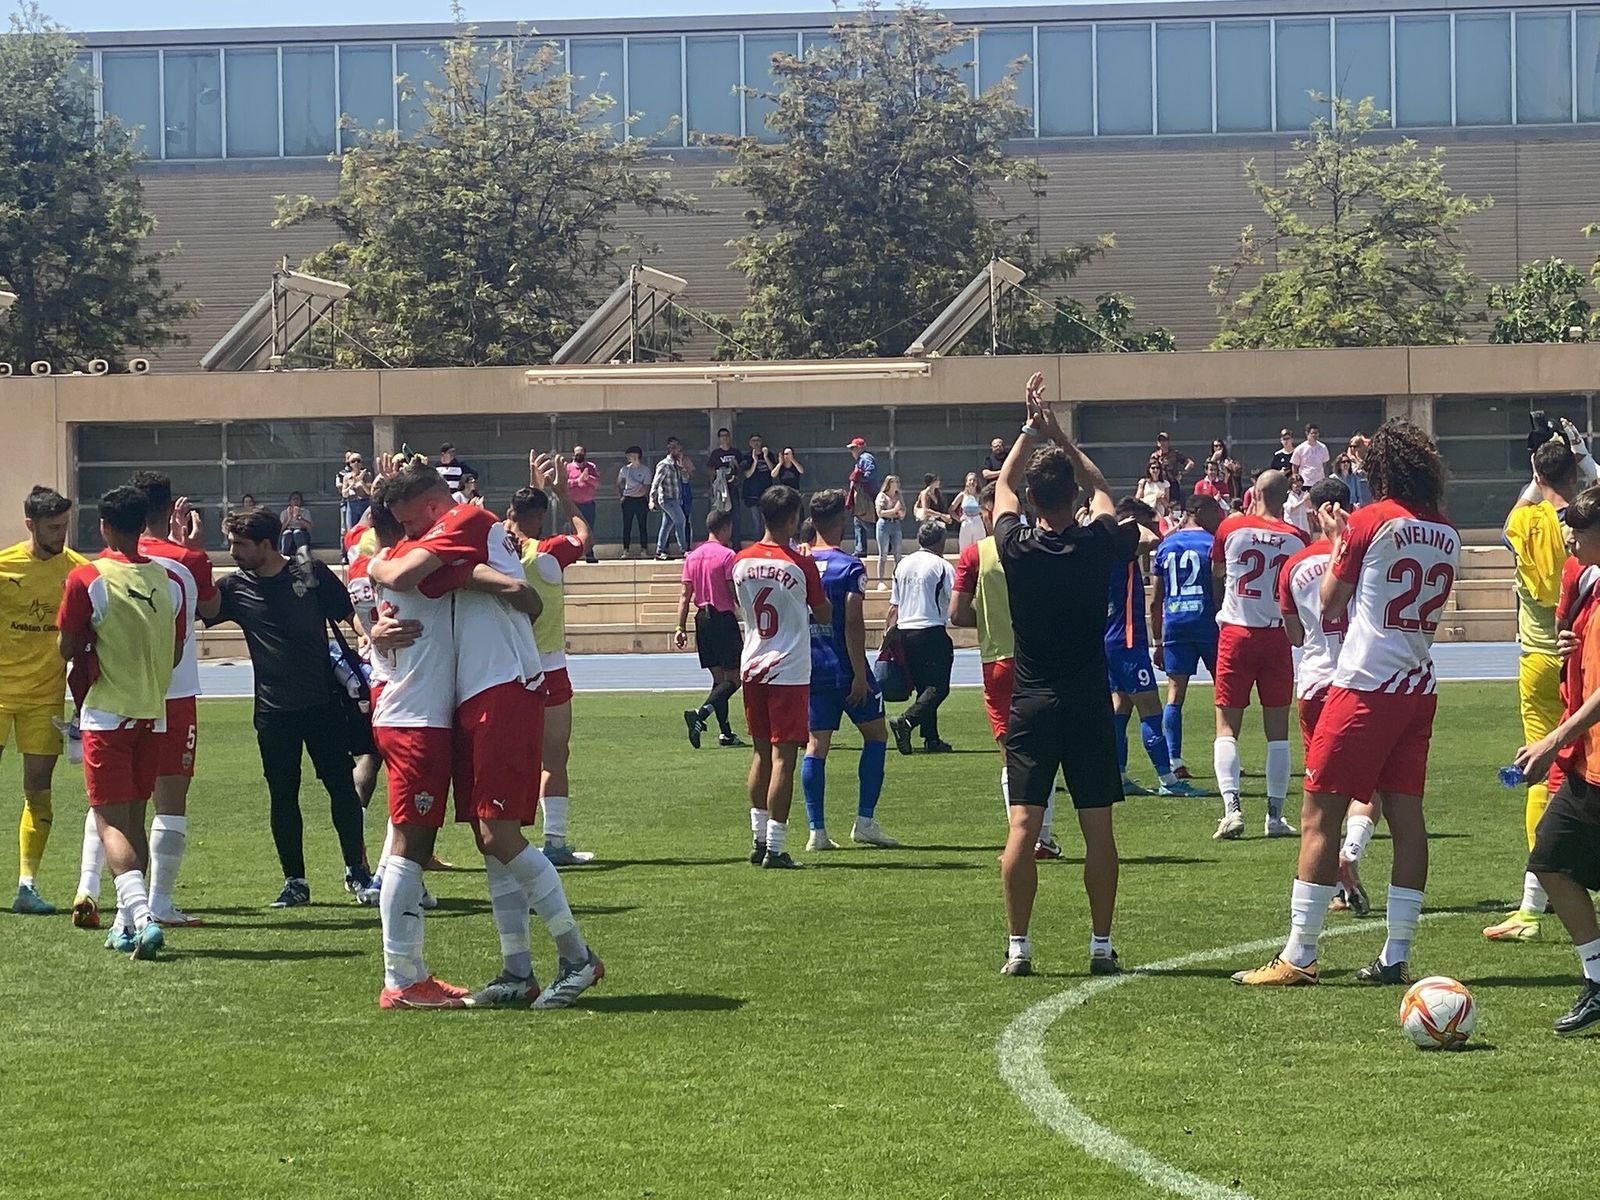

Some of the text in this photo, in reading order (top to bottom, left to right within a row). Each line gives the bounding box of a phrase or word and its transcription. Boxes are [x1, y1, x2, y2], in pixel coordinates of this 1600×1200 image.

[1251, 533, 1286, 549] ALEX
[1393, 526, 1454, 555] AVELINO
[747, 566, 799, 590] GILBERT
[1163, 549, 1203, 597] 12
[1236, 548, 1290, 602] 21
[1383, 557, 1455, 635] 22
[752, 586, 779, 640] 6
[10, 621, 41, 632] Arabian
[1138, 668, 1151, 687] 9
[875, 690, 884, 713] 7
[186, 724, 196, 750] 5
